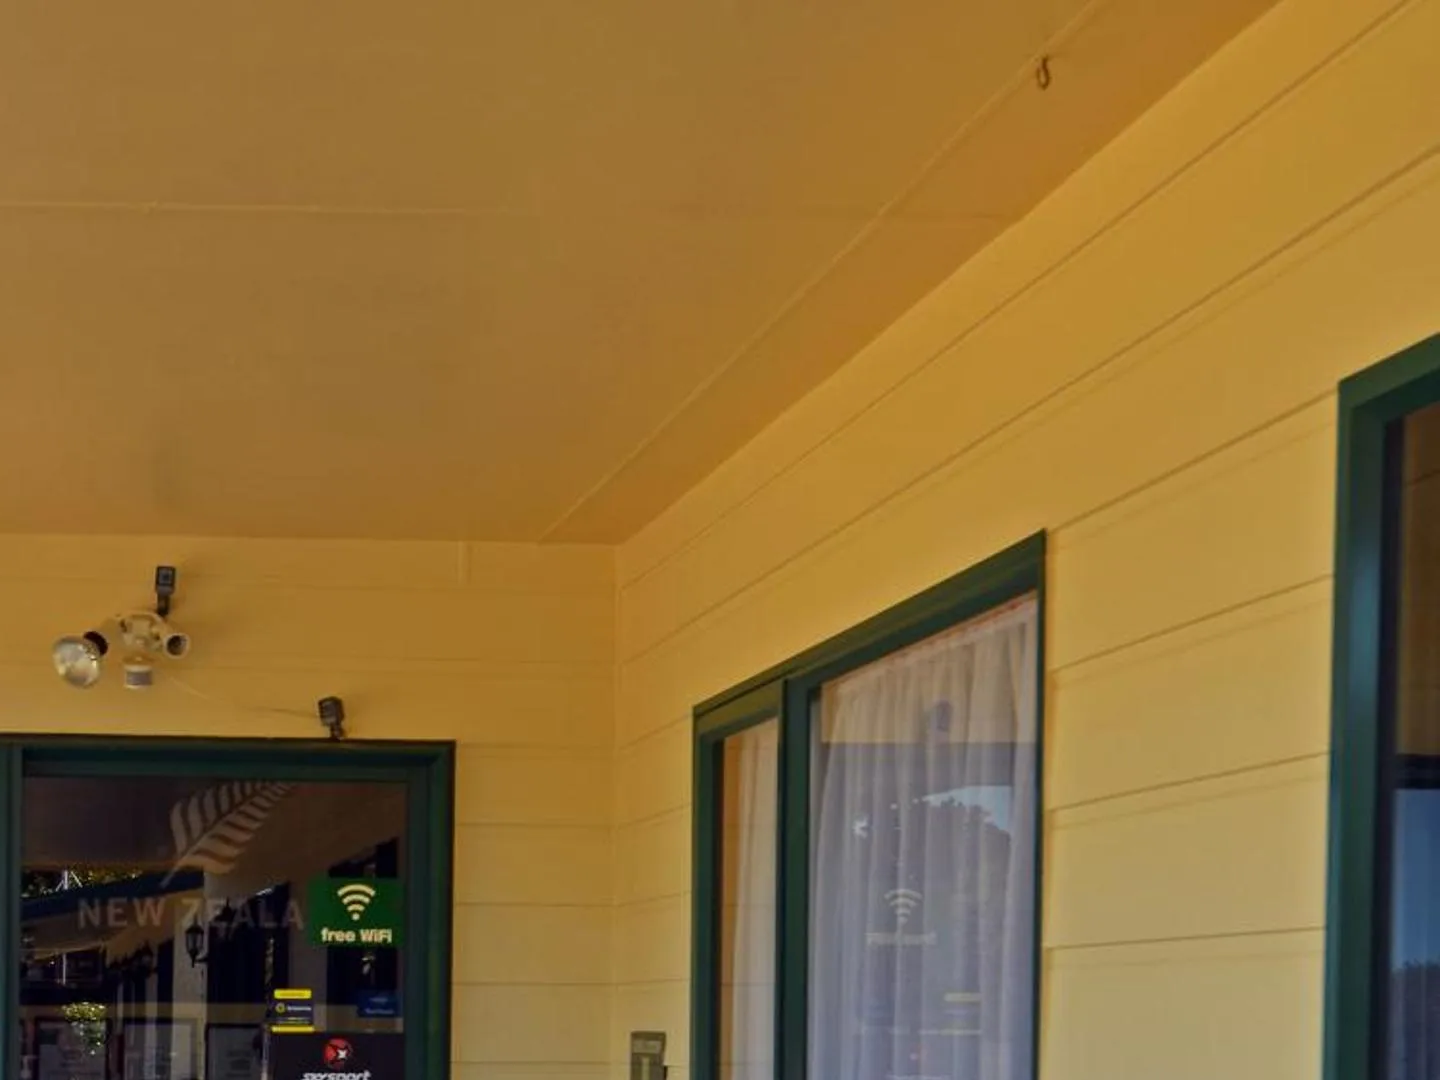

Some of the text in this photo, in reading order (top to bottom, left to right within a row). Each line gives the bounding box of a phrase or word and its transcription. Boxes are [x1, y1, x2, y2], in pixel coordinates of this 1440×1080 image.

[77, 897, 304, 930] NEW ZEALA
[321, 926, 356, 942] free
